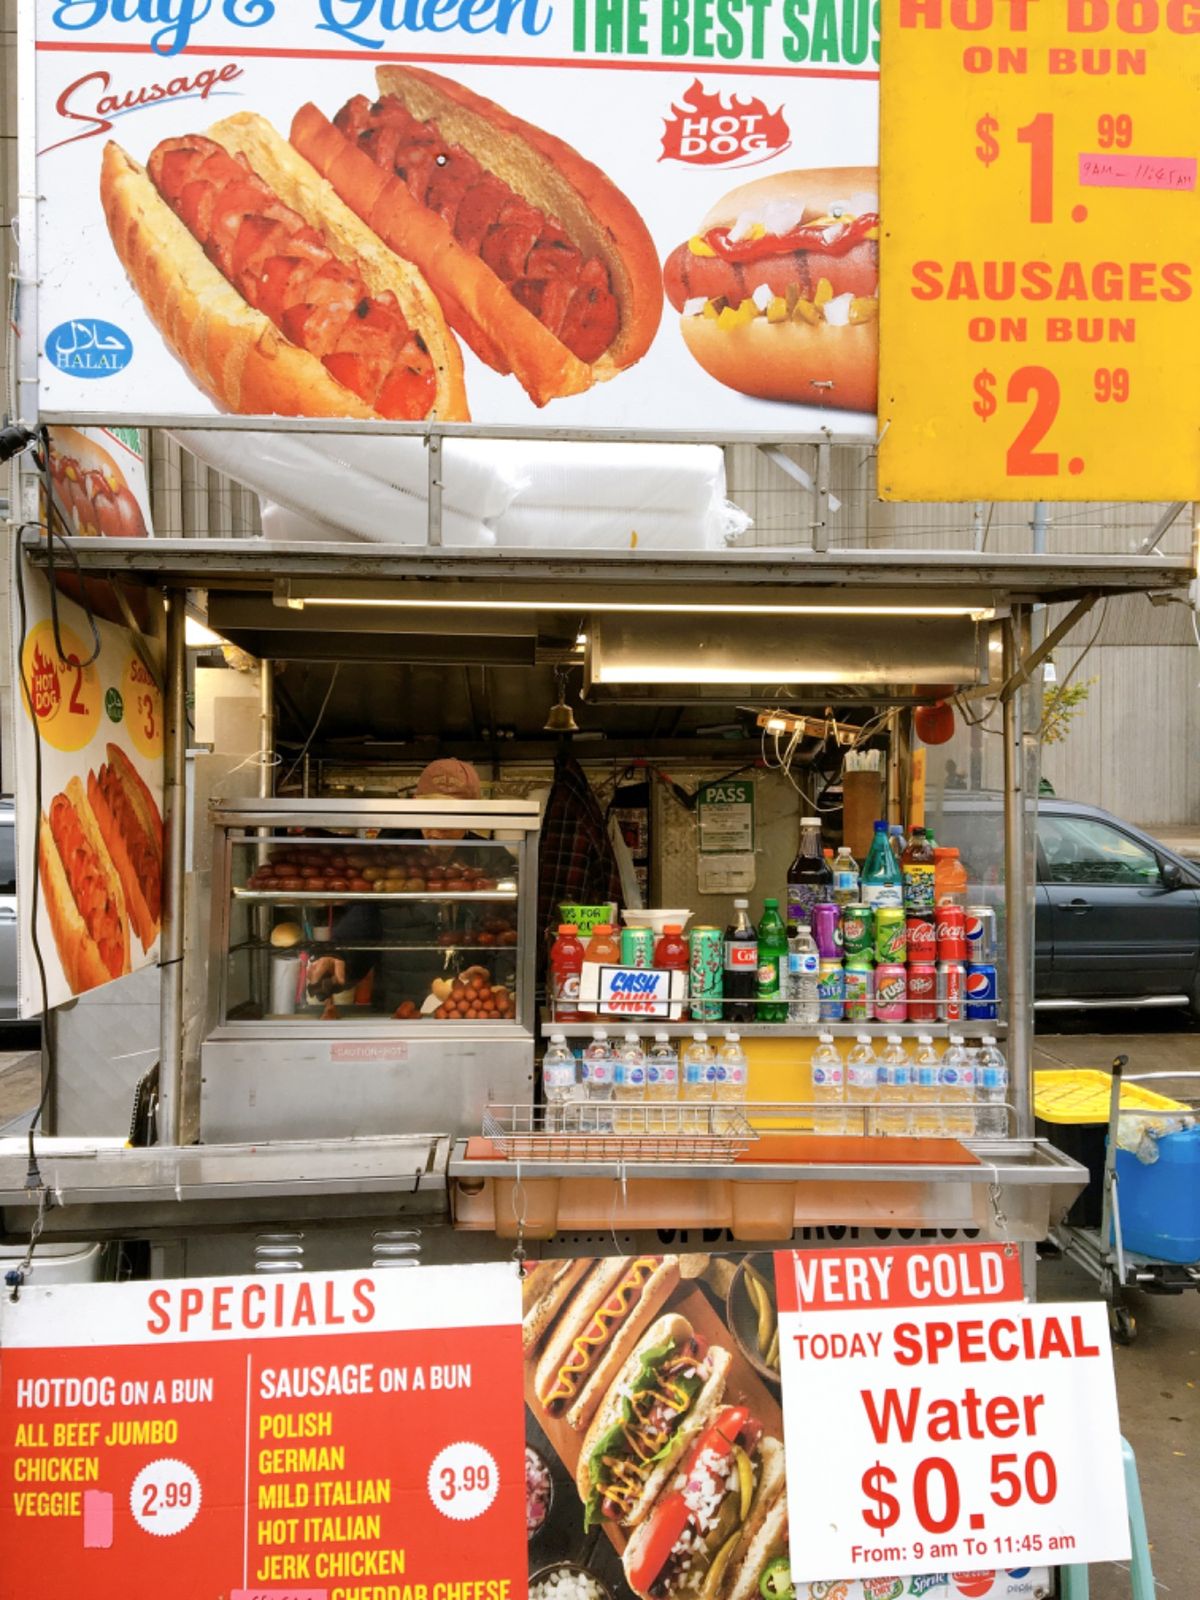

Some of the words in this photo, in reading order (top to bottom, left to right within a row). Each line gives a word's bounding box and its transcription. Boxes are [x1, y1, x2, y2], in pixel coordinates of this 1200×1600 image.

[572, 0, 649, 54] THE
[661, 0, 772, 59] BEST
[899, 0, 1040, 32] HOT
[962, 46, 1028, 74] ON
[1048, 48, 1147, 75] BUN
[37, 63, 244, 156] Sausage
[682, 114, 763, 136] HOT
[680, 134, 768, 156] DOG
[910, 260, 1193, 302] SAUSAGES
[968, 317, 1028, 342] ON
[1046, 318, 1136, 343] BUN
[56, 353, 125, 369] HALAL
[35, 673, 54, 691] HOT
[35, 690, 58, 709] DOG
[706, 788, 746, 803] PASS
[610, 971, 661, 993] CASH
[799, 1256, 894, 1303] VERY
[906, 1251, 1005, 1300] COLD
[147, 1278, 376, 1336] SPECIALS
[793, 1332, 882, 1360] TODAY
[893, 1316, 1100, 1367] SPECIAL
[16, 1376, 115, 1408] HOTDOG
[121, 1381, 148, 1405] ON
[153, 1380, 166, 1404] A
[171, 1378, 214, 1402] BUN
[260, 1363, 374, 1400] SAUSAGE
[379, 1368, 407, 1392] ON
[412, 1367, 425, 1390] A
[430, 1364, 472, 1388] BUN
[259, 1412, 332, 1439] POLISH
[860, 1387, 1045, 1444] Water
[15, 1423, 48, 1447] ALL
[53, 1422, 101, 1447] BEEF
[105, 1419, 178, 1446] JUMBO
[13, 1457, 99, 1482] CHICKEN
[258, 1446, 345, 1474] GERMAN
[258, 1482, 309, 1510] MILD
[315, 1478, 391, 1507] ITALIAN
[440, 1465, 490, 1502] 3.99
[13, 1492, 81, 1517] VEGGIE
[142, 1482, 192, 1517] 2.99
[257, 1518, 298, 1546] HOT
[304, 1515, 381, 1543] ITALIAN
[851, 1544, 908, 1564] From:
[913, 1542, 924, 1559] 9
[930, 1544, 958, 1558] am
[963, 1538, 988, 1556] To
[995, 1534, 1043, 1553] 11:45
[1048, 1533, 1077, 1550] am
[257, 1553, 309, 1581] JERK
[315, 1549, 405, 1578] CHICKEN
[331, 1585, 427, 1600] CHEDDAR
[433, 1579, 511, 1600] CHEESE
